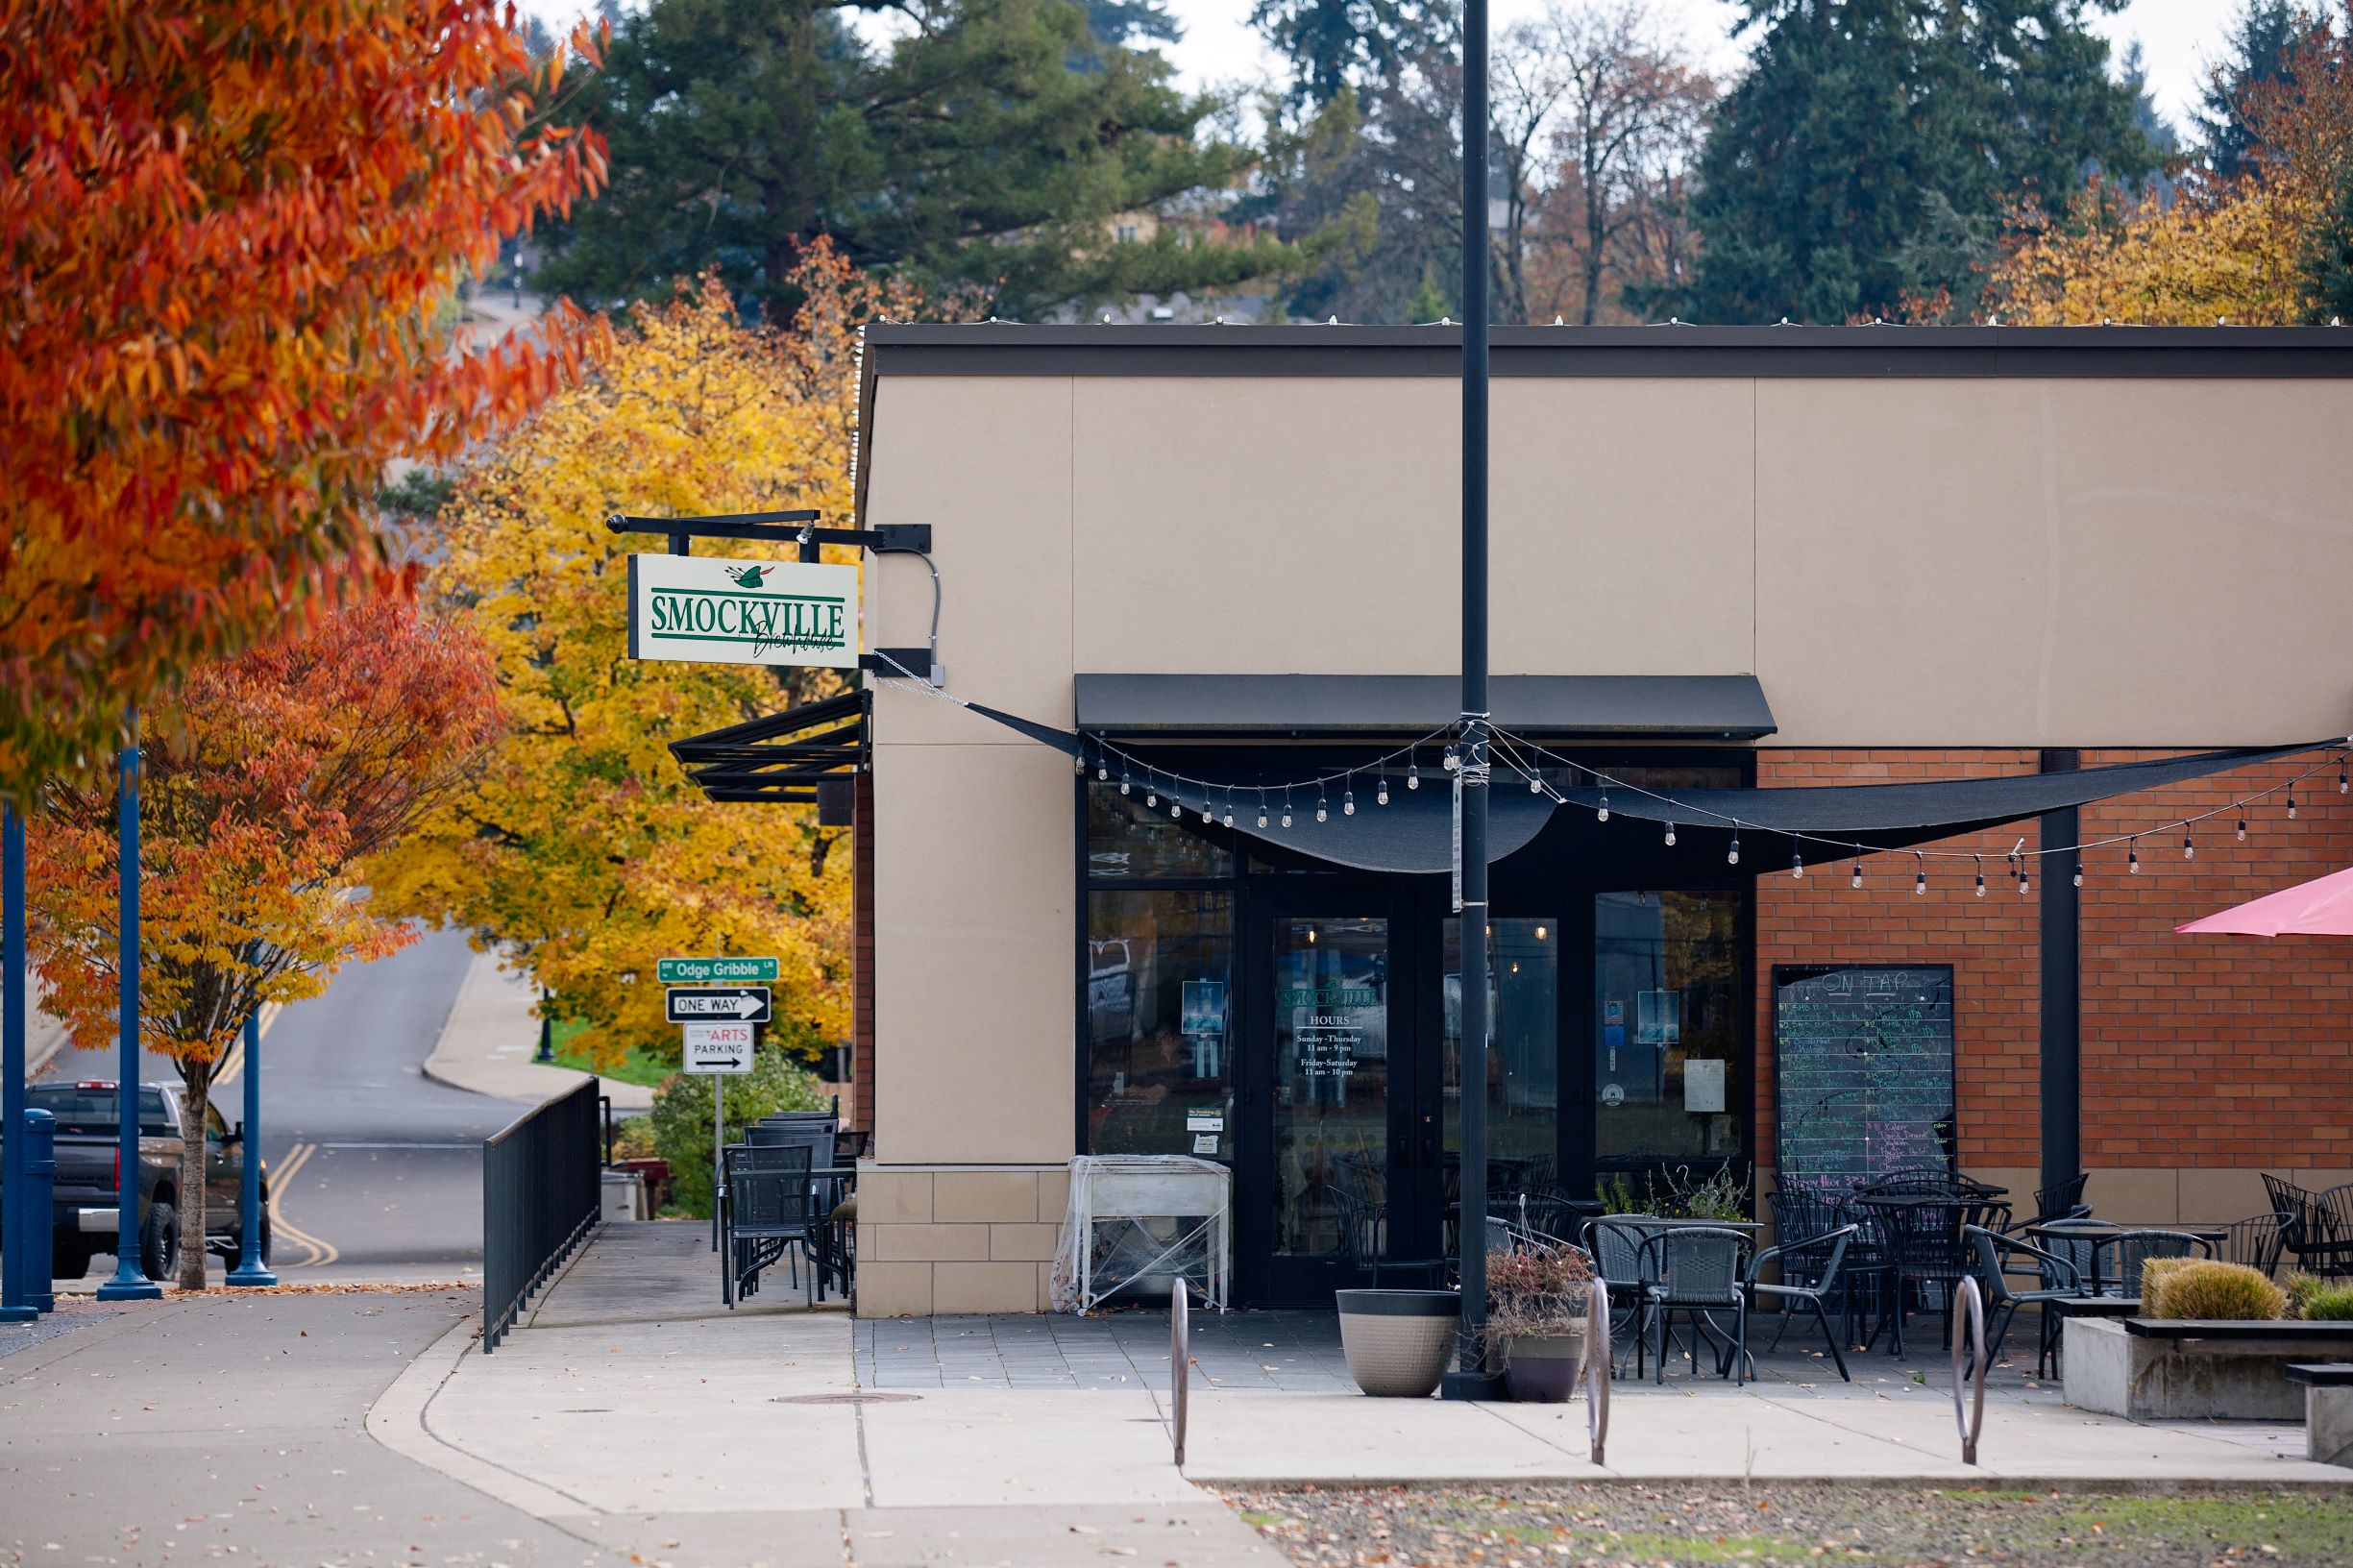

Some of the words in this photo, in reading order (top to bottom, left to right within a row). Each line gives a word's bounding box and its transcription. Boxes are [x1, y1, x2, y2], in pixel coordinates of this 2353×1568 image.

[651, 595, 845, 639] SMOCKVILLE
[752, 620, 836, 658] Brewhouse
[676, 963, 710, 979] Odge
[713, 963, 759, 976] Gribble
[1822, 973, 1853, 992] ON
[1863, 972, 1908, 992] TAP
[678, 999, 705, 1012] ONE
[710, 998, 738, 1012] WAY
[1311, 1016, 1350, 1025] HOURS
[710, 1029, 748, 1041] ARTS
[694, 1044, 743, 1054] PARKING
[1300, 1059, 1358, 1068] Friday-Saturday
